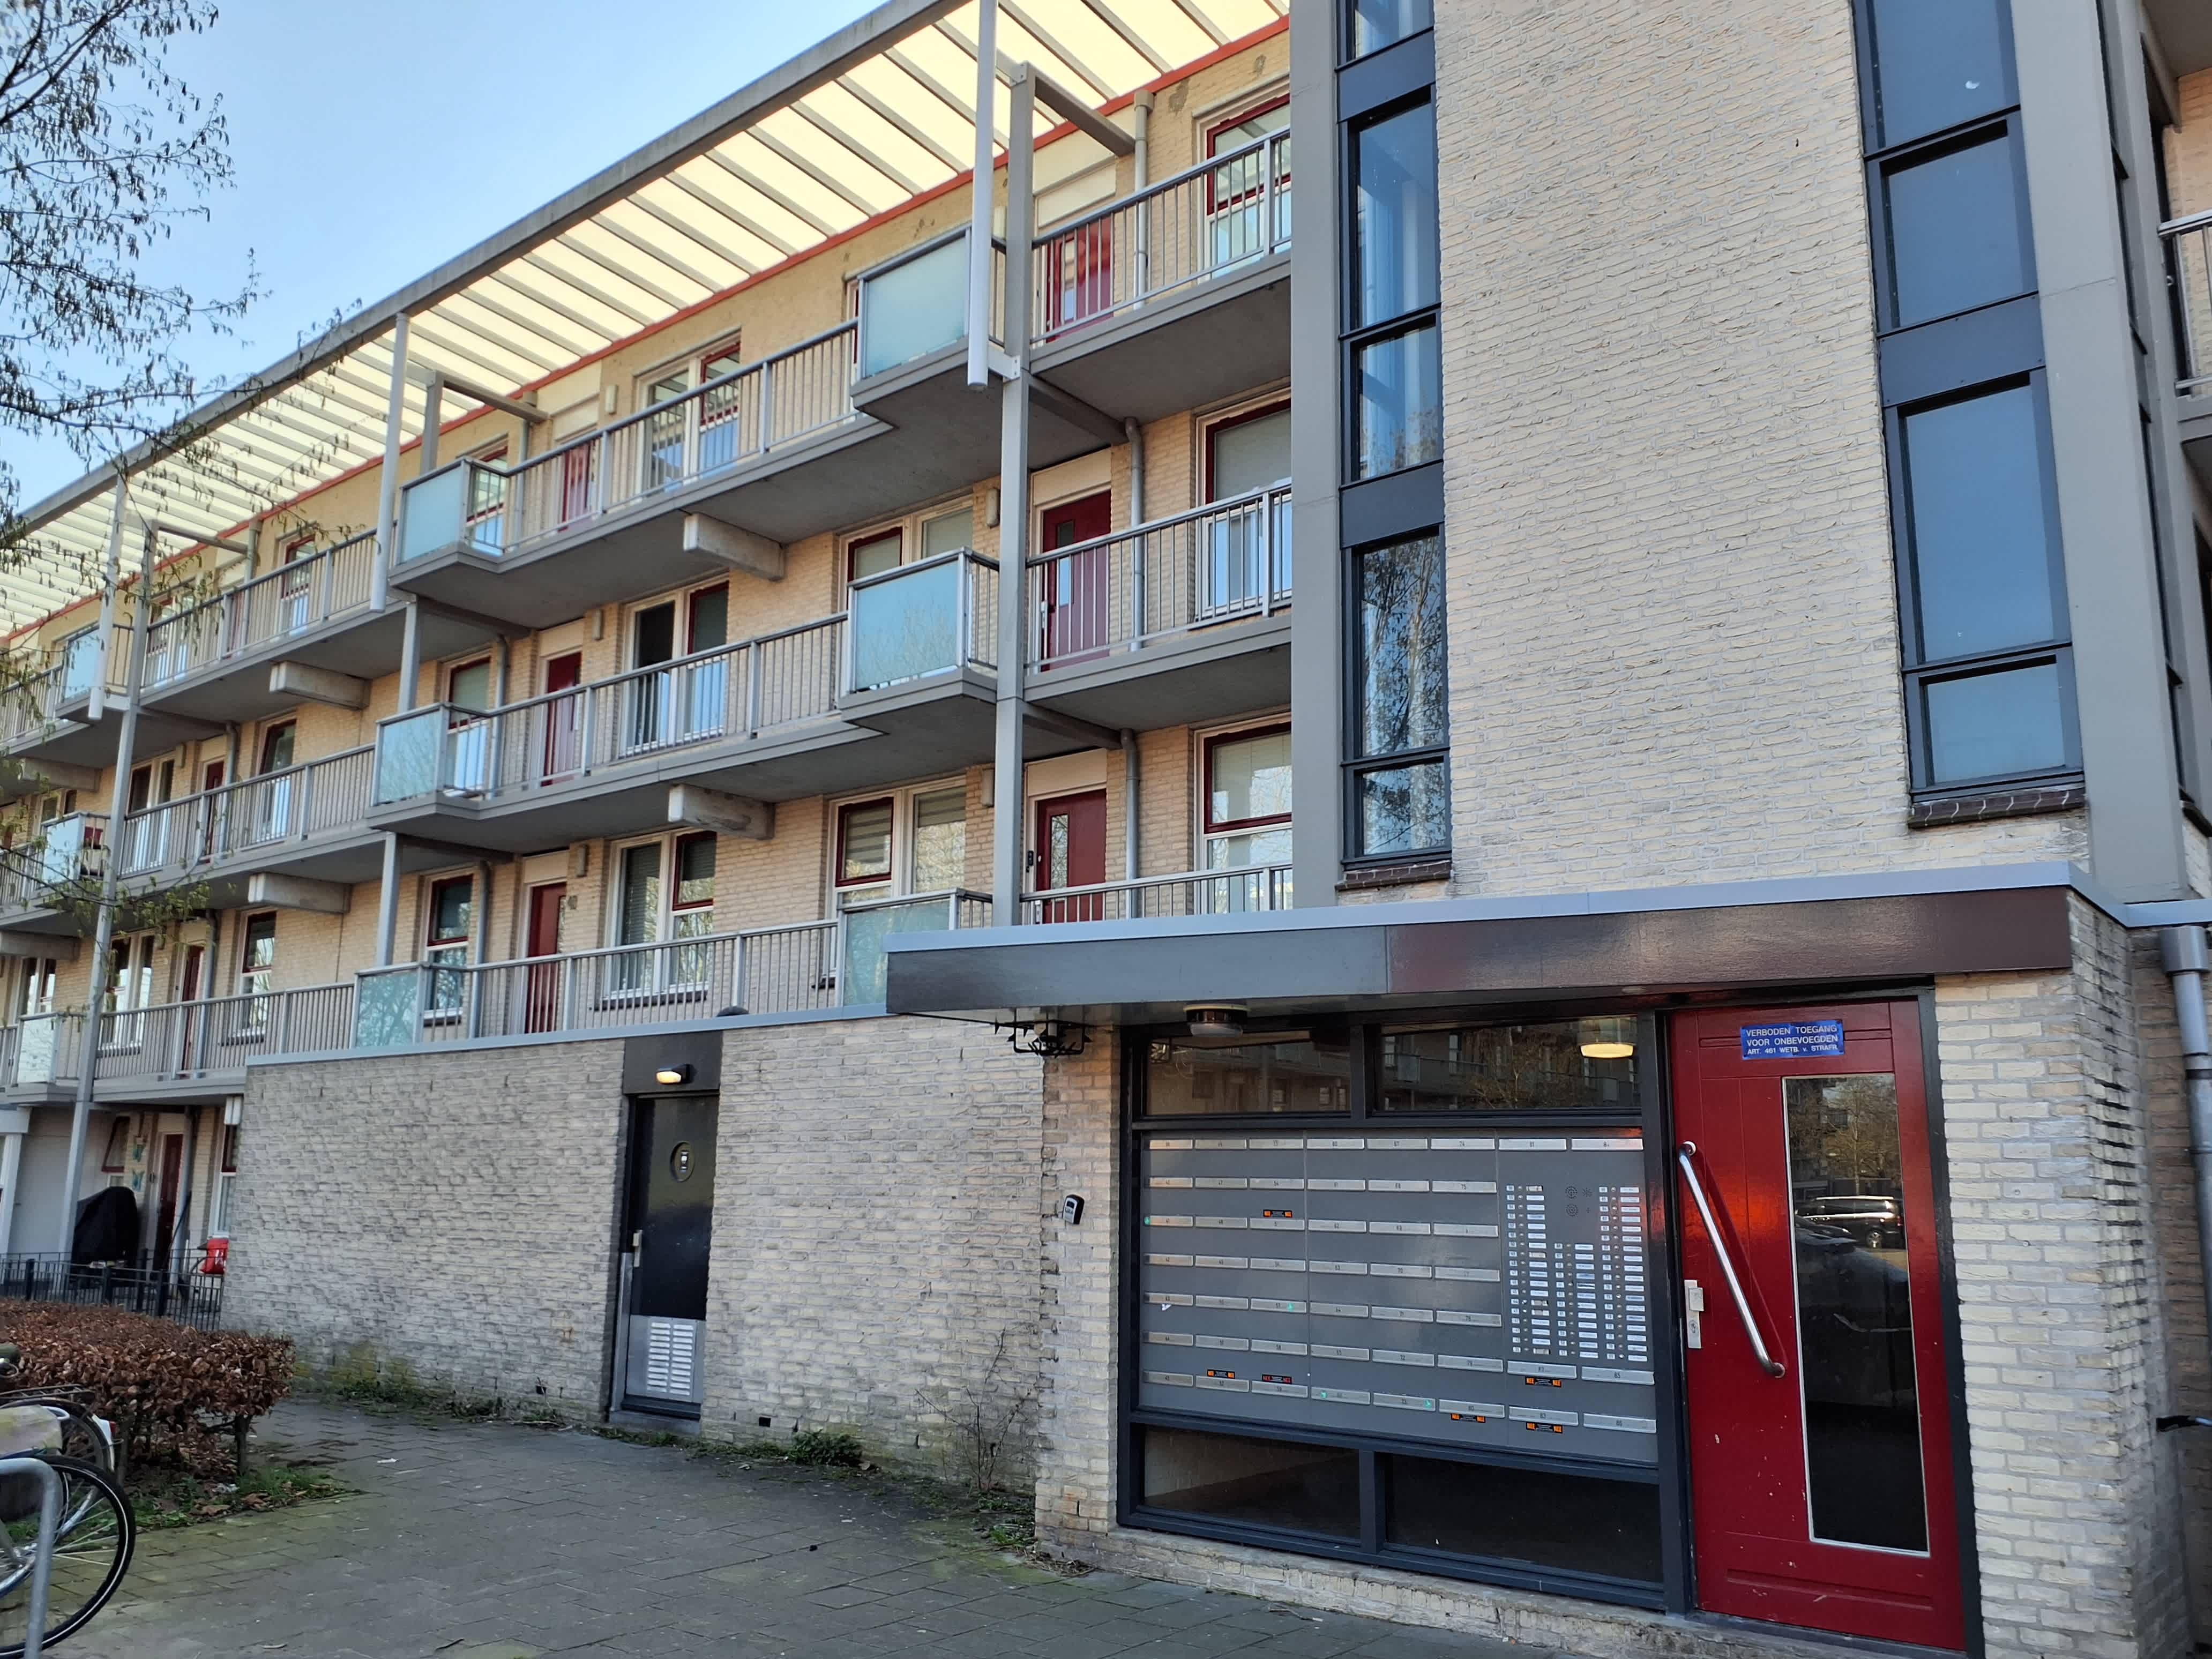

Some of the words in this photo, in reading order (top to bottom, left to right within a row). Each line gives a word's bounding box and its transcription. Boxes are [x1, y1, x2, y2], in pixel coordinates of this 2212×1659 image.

[1746, 1027, 1791, 1037] VERBODEN
[1796, 1024, 1837, 1034] TOEGANG
[1747, 1038, 1770, 1047] VOOR
[1774, 1035, 1839, 1045] ONBEVOEGDEN
